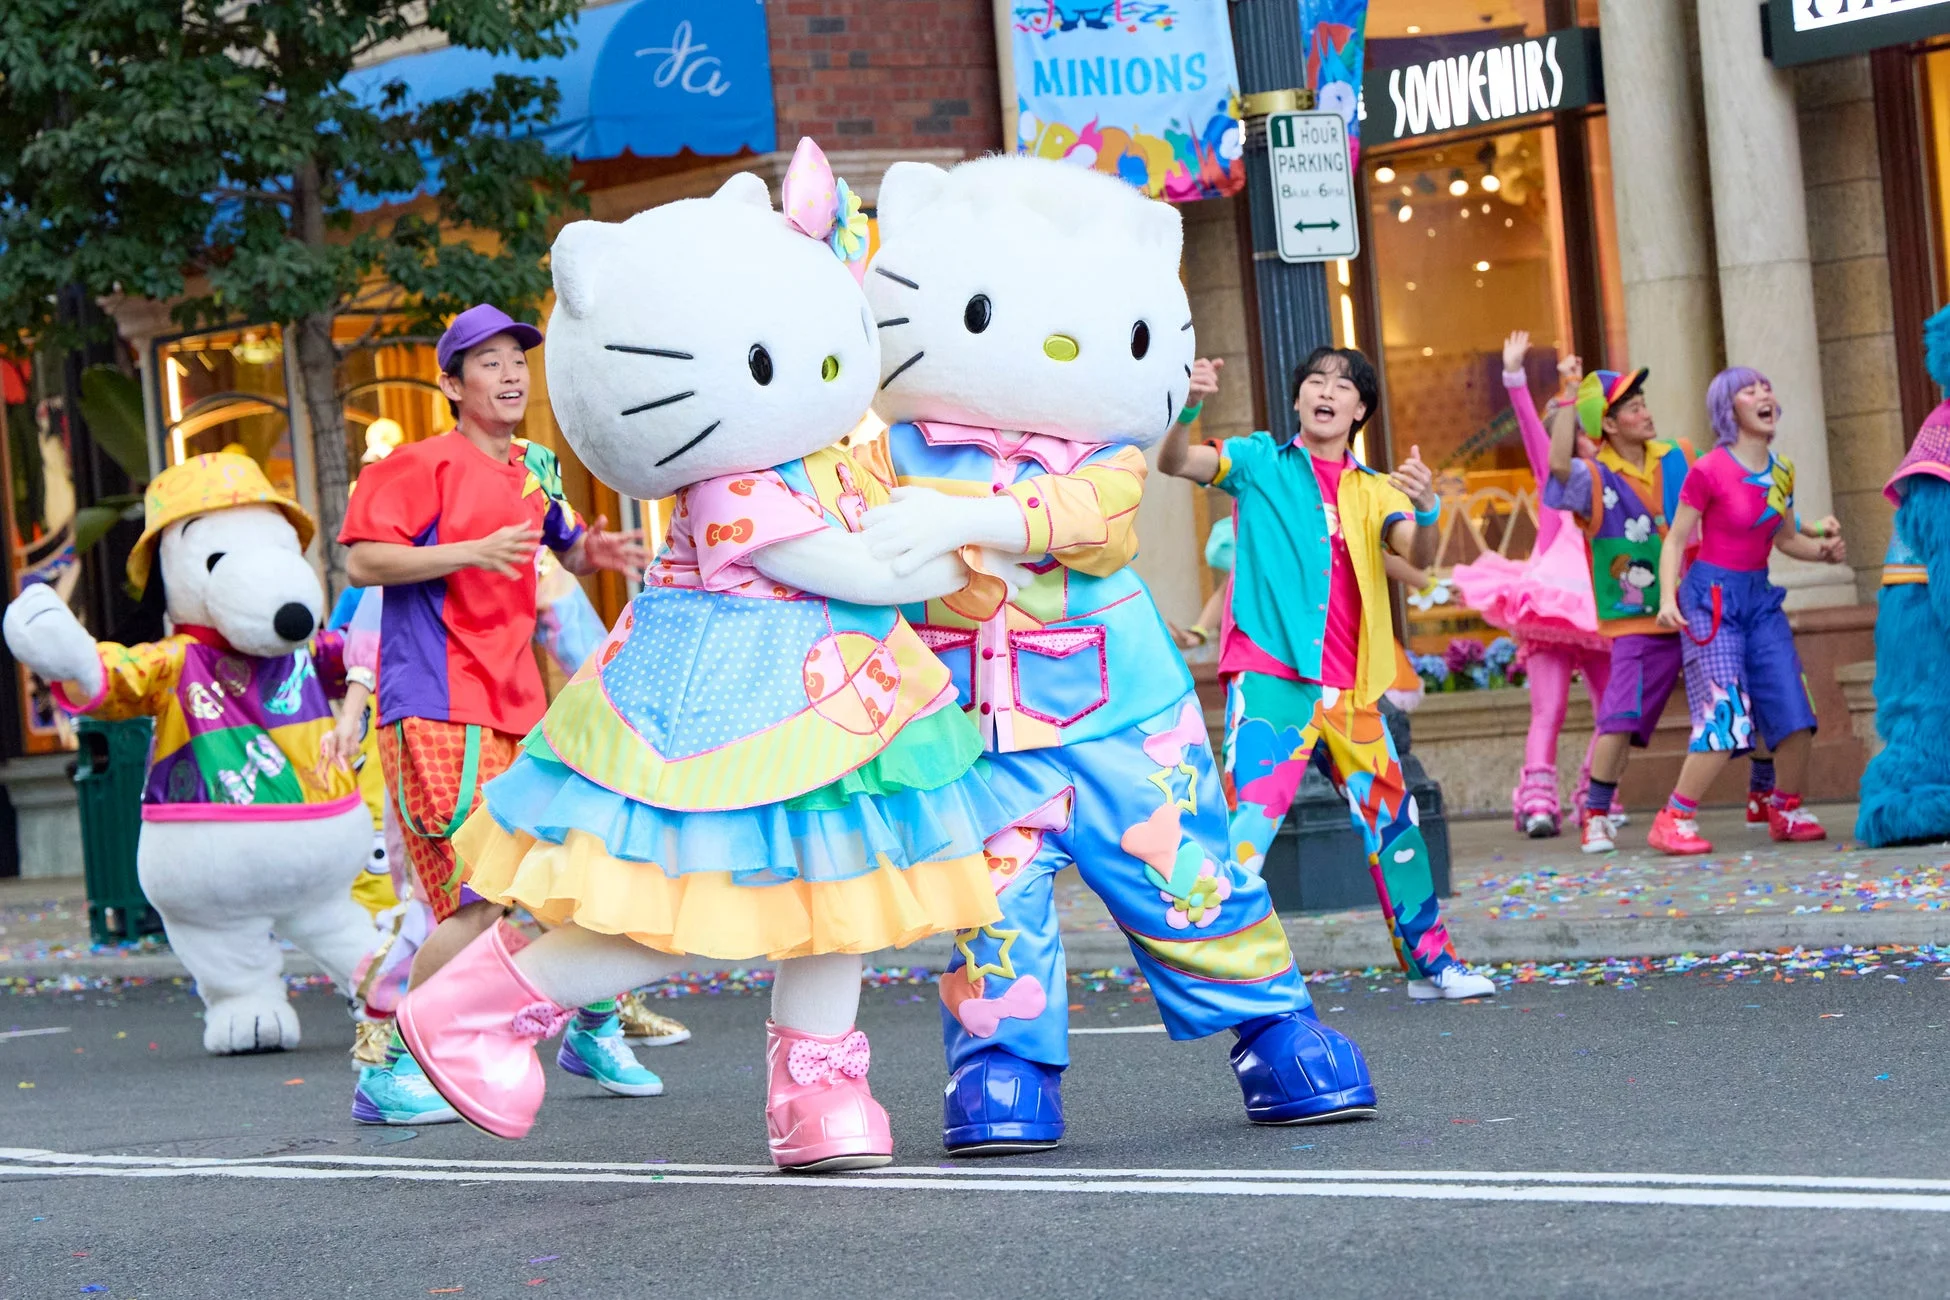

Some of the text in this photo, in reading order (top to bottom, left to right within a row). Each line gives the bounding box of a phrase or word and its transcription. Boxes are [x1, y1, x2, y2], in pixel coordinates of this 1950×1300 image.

[1033, 52, 1208, 97] MINIONS
[1388, 36, 1564, 138] SOUVENIRS
[1278, 119, 1339, 147] 1 HOUR
[1278, 152, 1344, 173] PARKING
